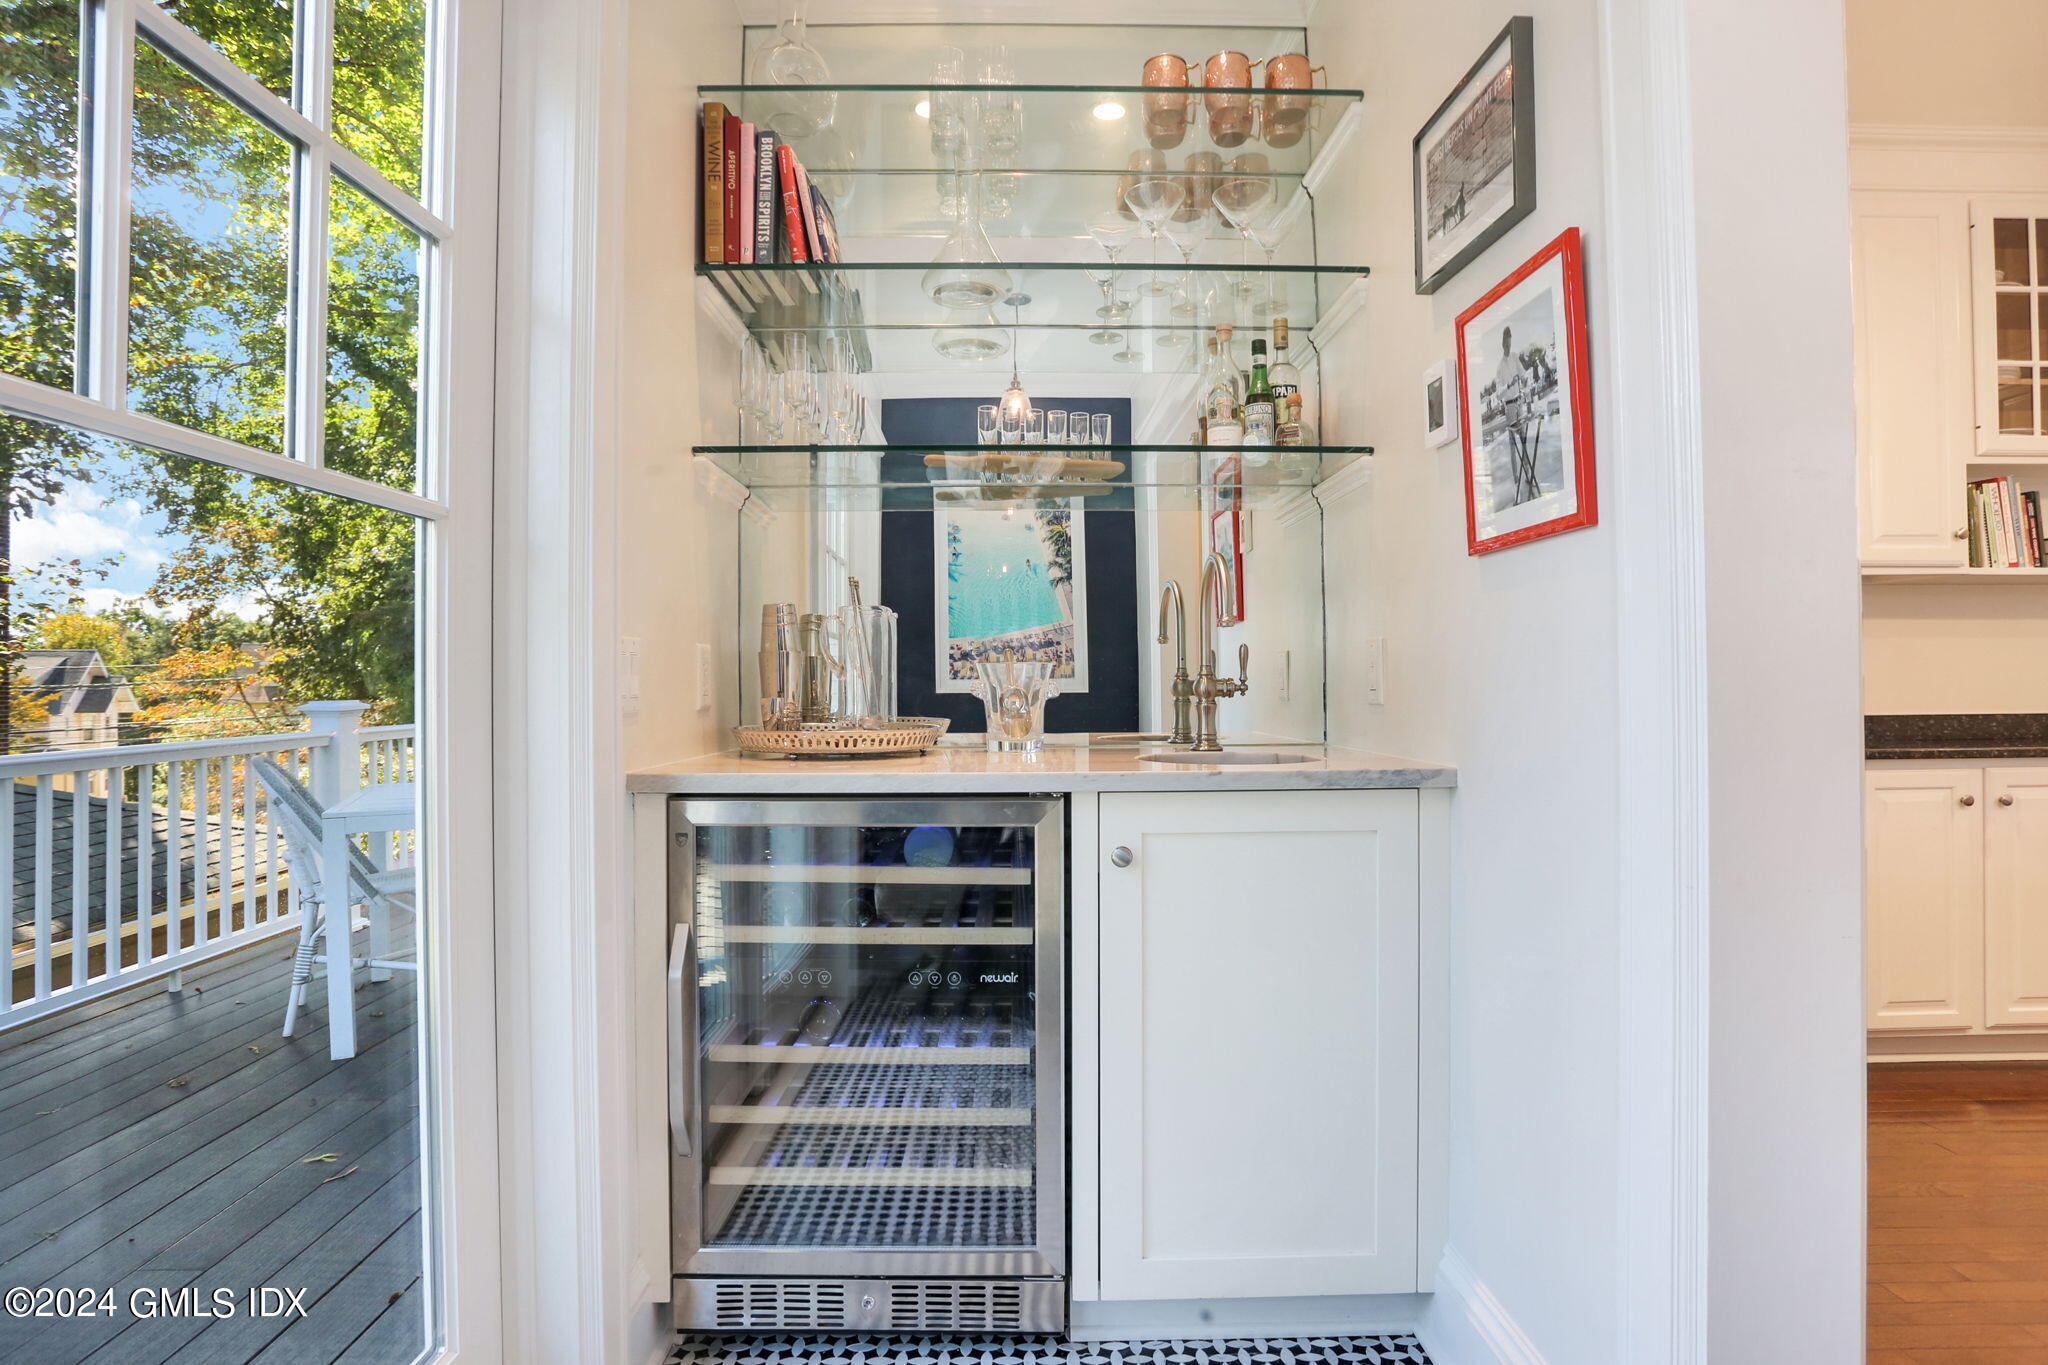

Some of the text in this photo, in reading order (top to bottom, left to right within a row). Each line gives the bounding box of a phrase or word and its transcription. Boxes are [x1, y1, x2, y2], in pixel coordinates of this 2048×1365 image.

[708, 140, 721, 183] WINE
[727, 150, 736, 190] APERITIVO
[759, 137, 774, 191] BROOKLYN
[757, 201, 771, 243] SPIRITS
[980, 972, 1019, 983] newair
